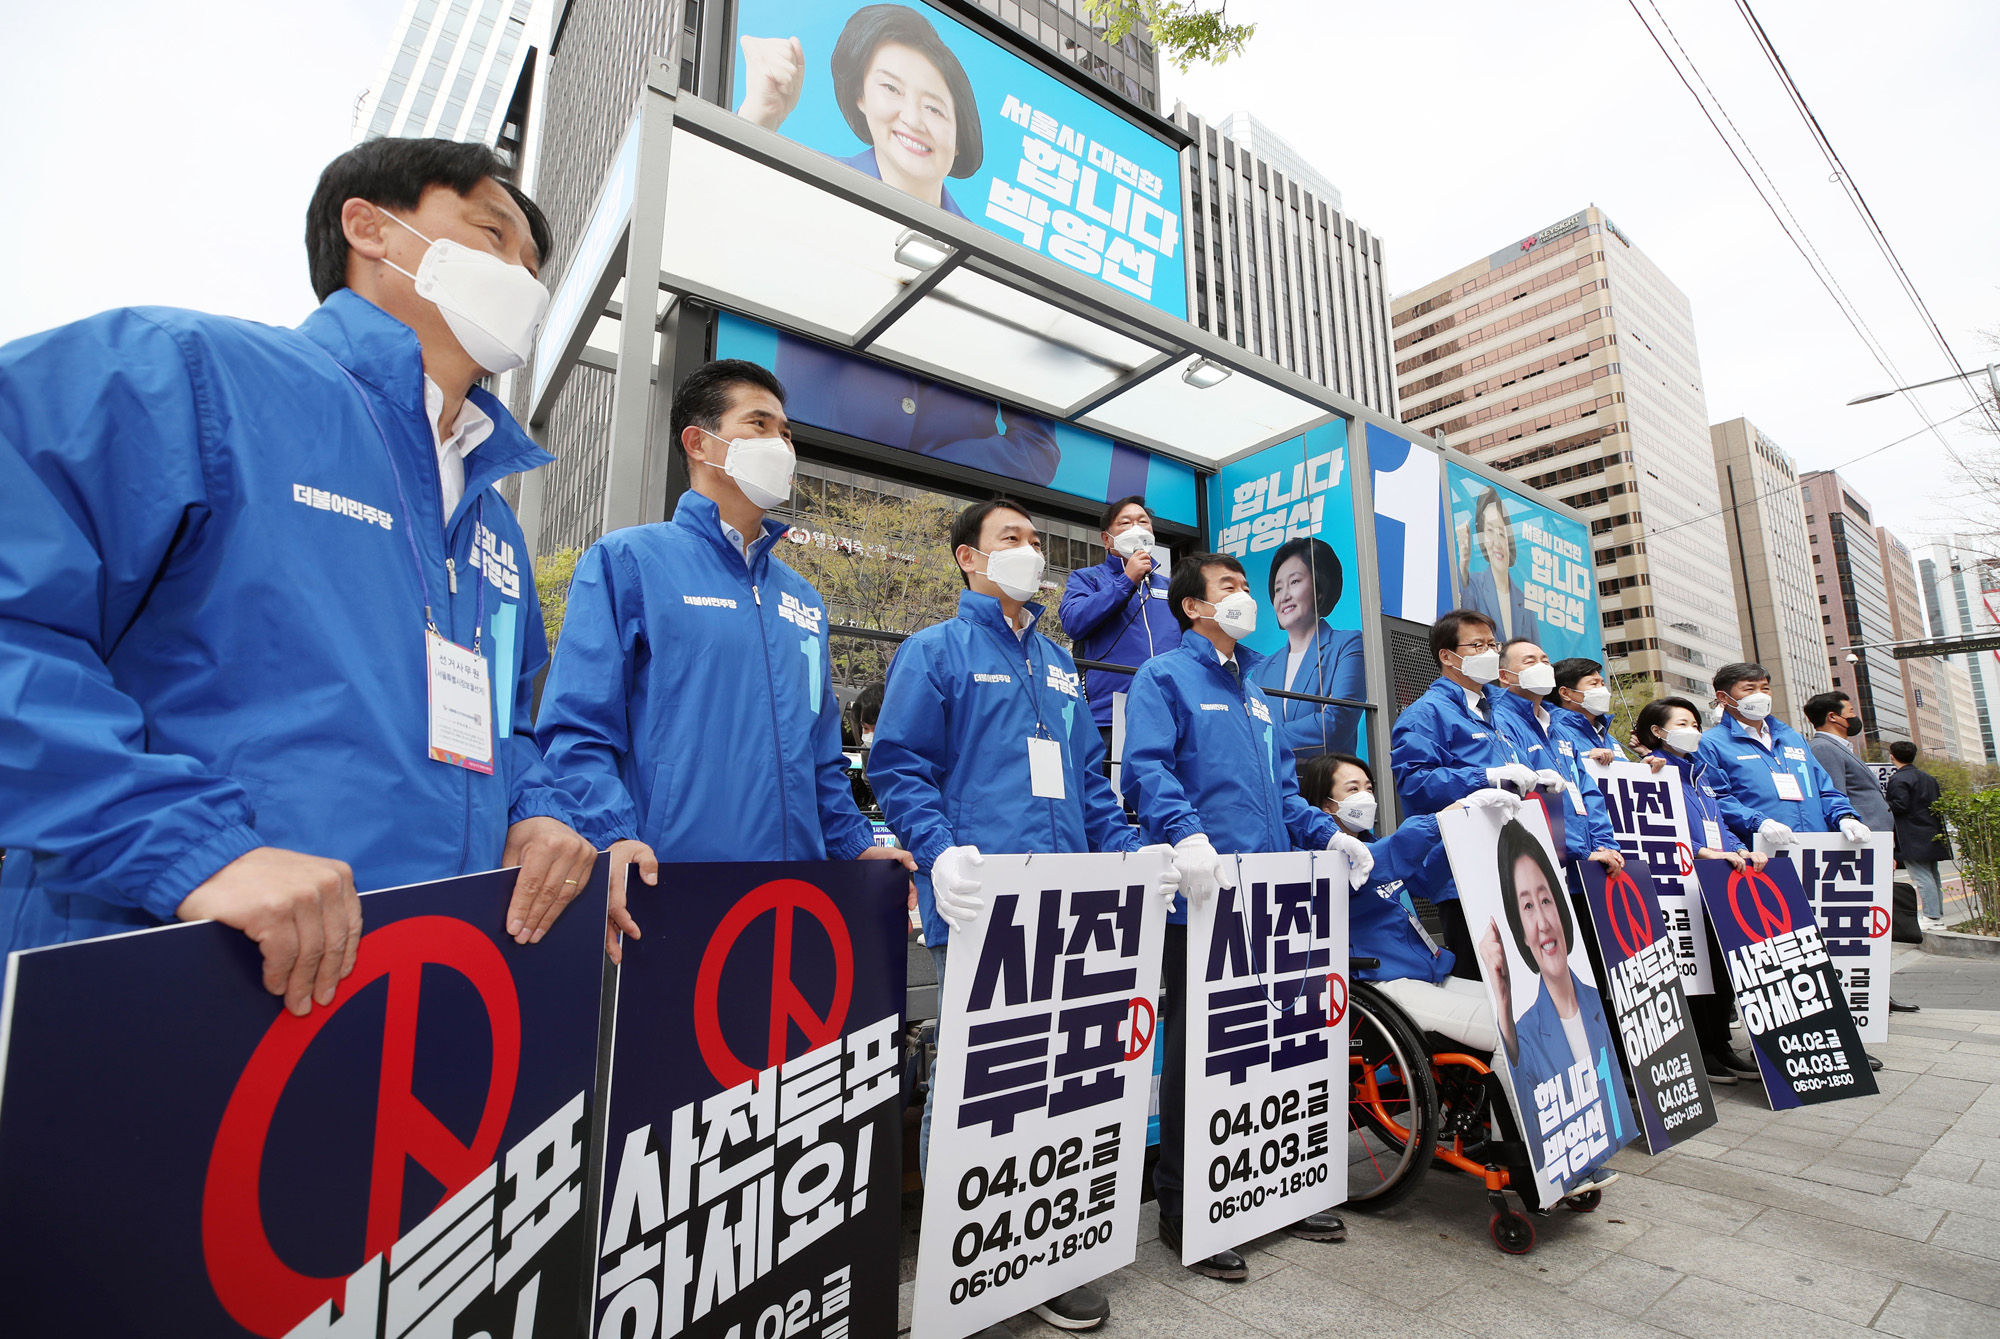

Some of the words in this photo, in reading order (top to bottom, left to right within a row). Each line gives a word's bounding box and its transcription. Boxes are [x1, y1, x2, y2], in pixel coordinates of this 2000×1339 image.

[1000, 94, 1086, 158] 서울시
[1087, 140, 1163, 200] 대전환
[1017, 135, 1179, 258] 합니다
[1539, 215, 1580, 239] KEYSIGHT
[985, 176, 1155, 301] 박영선
[293, 484, 393, 530] 더불어민주당
[1231, 446, 1344, 522] 합니다
[1217, 495, 1325, 558] 박영선
[1374, 442, 1440, 626] 1
[1522, 522, 1552, 550] 서울시
[1554, 535, 1582, 562] 대전환
[683, 595, 737, 609] 더불어민주당
[1524, 581, 1585, 634] 박영선
[1531, 546, 1591, 600] 합니다
[439, 654, 480, 680] 선거사무원
[1598, 777, 1677, 837] 사전
[966, 885, 1145, 1012] 사전
[1205, 878, 1330, 982] 사전
[1728, 924, 1829, 993] 사전투표
[1812, 906, 1870, 956] 표
[1610, 936, 1678, 1018] 사전투표
[1739, 969, 1833, 1036] 하세요!
[1205, 974, 1328, 1086] 투표
[1621, 986, 1684, 1067] 하세요!
[1778, 1028, 1842, 1054] 04.02.금
[957, 998, 1129, 1138] 투표
[1533, 1055, 1599, 1136] 합니다
[1651, 1052, 1692, 1087] 04.02.금
[1657, 1078, 1699, 1113] 04.03.토
[1786, 1051, 1850, 1077] 04.03.토
[1793, 1073, 1855, 1093] 06:00~18:00
[600, 1014, 899, 1260] 사전투표
[1209, 1079, 1329, 1146] 04.02.금
[1543, 1100, 1609, 1181] 박영선
[1663, 1102, 1702, 1131] 06:00~18:00
[958, 1122, 1121, 1210] 04.02.금
[1208, 1121, 1329, 1192] 04.03.토
[952, 1171, 1117, 1267] 04.03.토
[1209, 1163, 1328, 1224] 06:00~18:00
[600, 1122, 874, 1339] 하세요!
[949, 1220, 1113, 1305] 06:00~18:00
